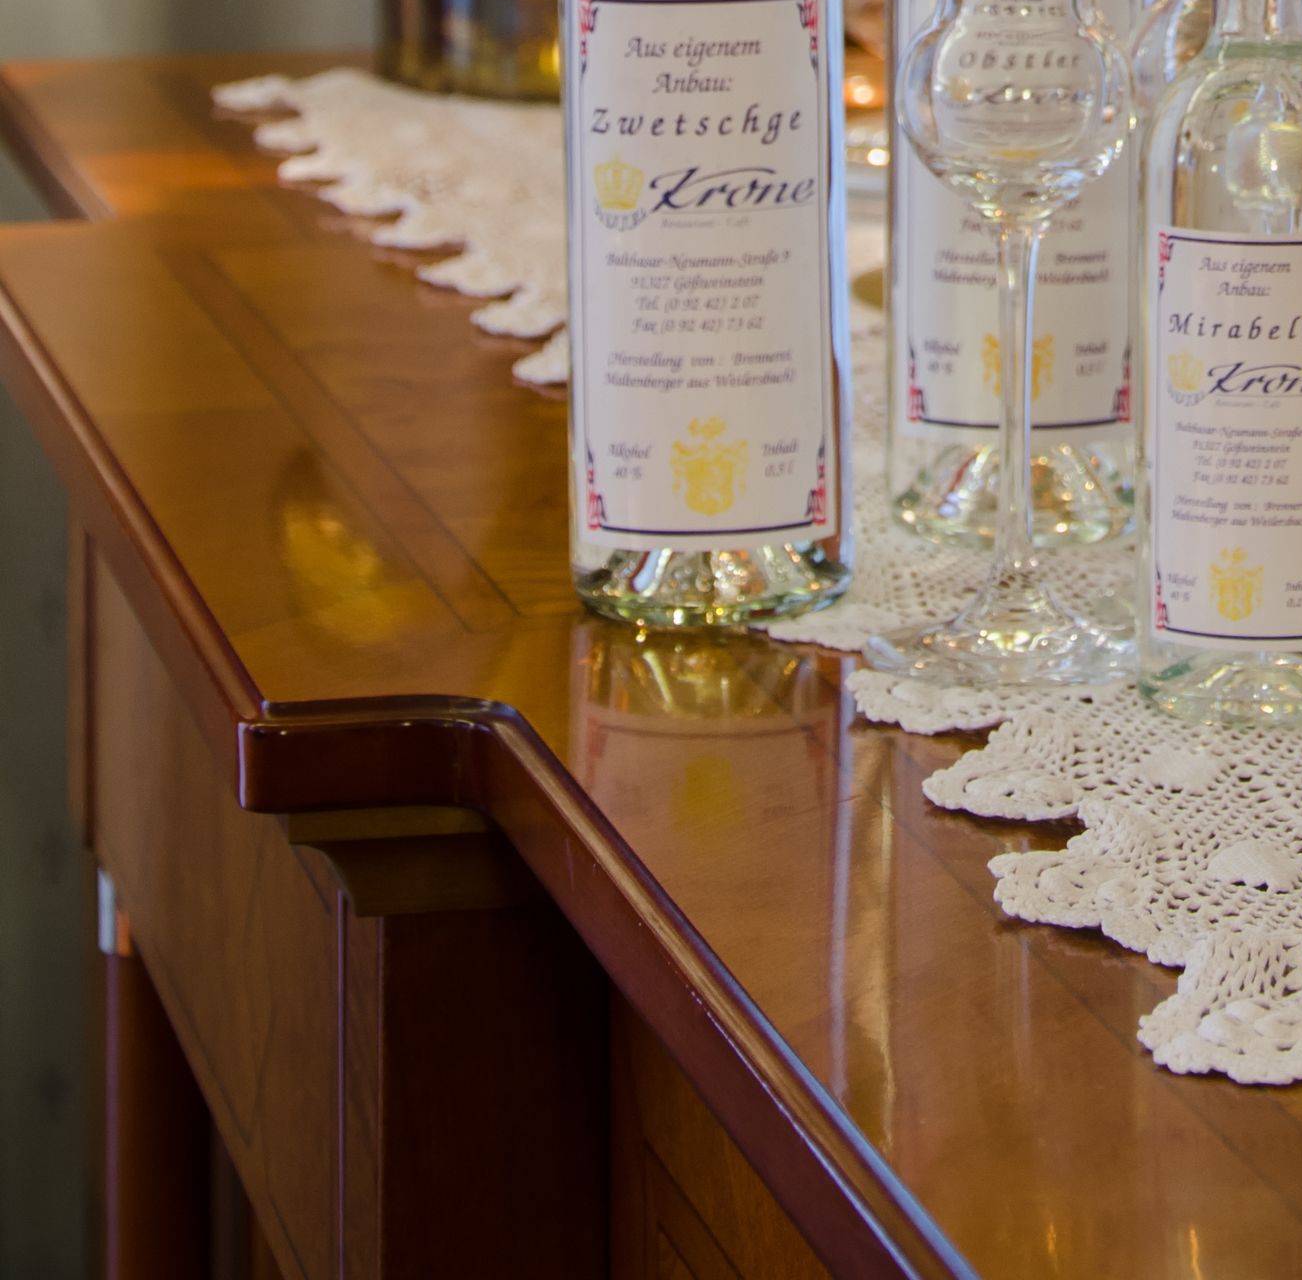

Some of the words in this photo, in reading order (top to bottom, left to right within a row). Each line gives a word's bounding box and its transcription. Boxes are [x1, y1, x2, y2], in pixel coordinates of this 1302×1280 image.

[625, 37, 665, 58] Aus
[673, 36, 761, 67] eigenem
[652, 70, 733, 93] Anbau:
[591, 102, 802, 144] Zwetschge
[649, 166, 815, 213] Krone
[1198, 257, 1227, 271] Aus
[1232, 260, 1291, 279] eigenem
[1216, 281, 1270, 296] Anbau:
